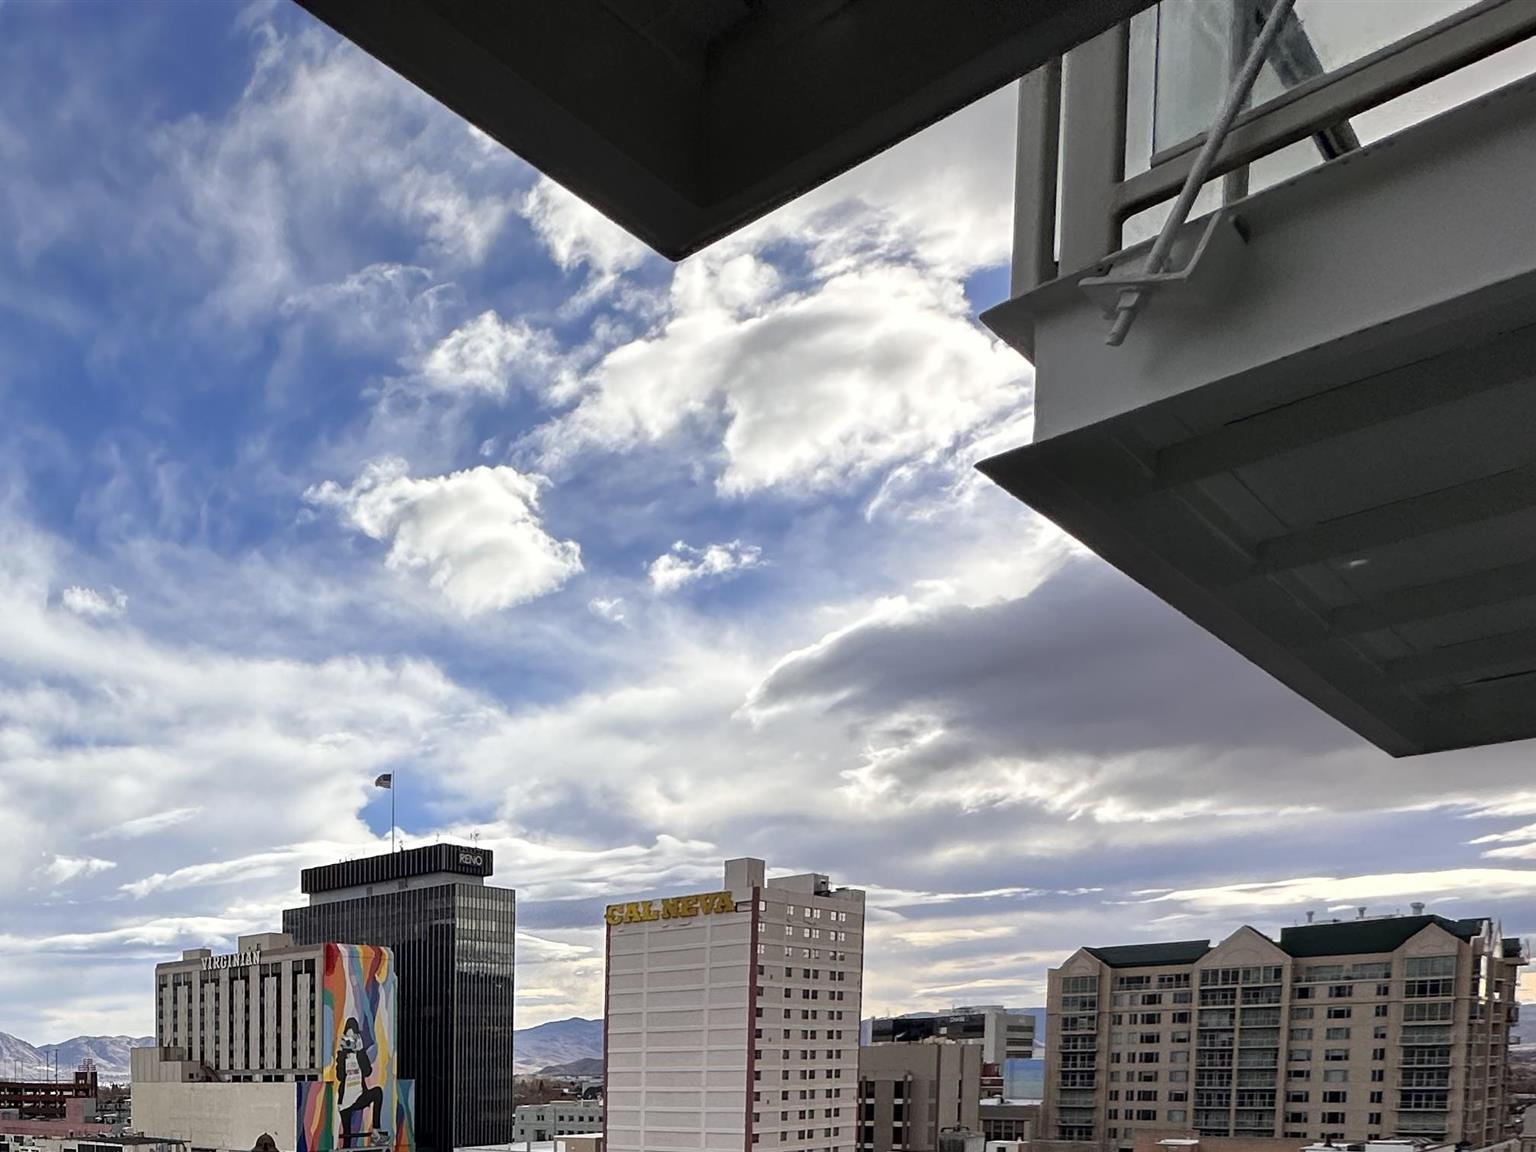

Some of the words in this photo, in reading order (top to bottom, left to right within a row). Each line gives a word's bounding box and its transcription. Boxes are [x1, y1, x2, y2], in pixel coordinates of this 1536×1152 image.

[459, 853, 483, 866] RENO
[607, 901, 659, 925] CAL
[661, 891, 736, 918] NEVA
[201, 950, 261, 970] VIRGINIAN
